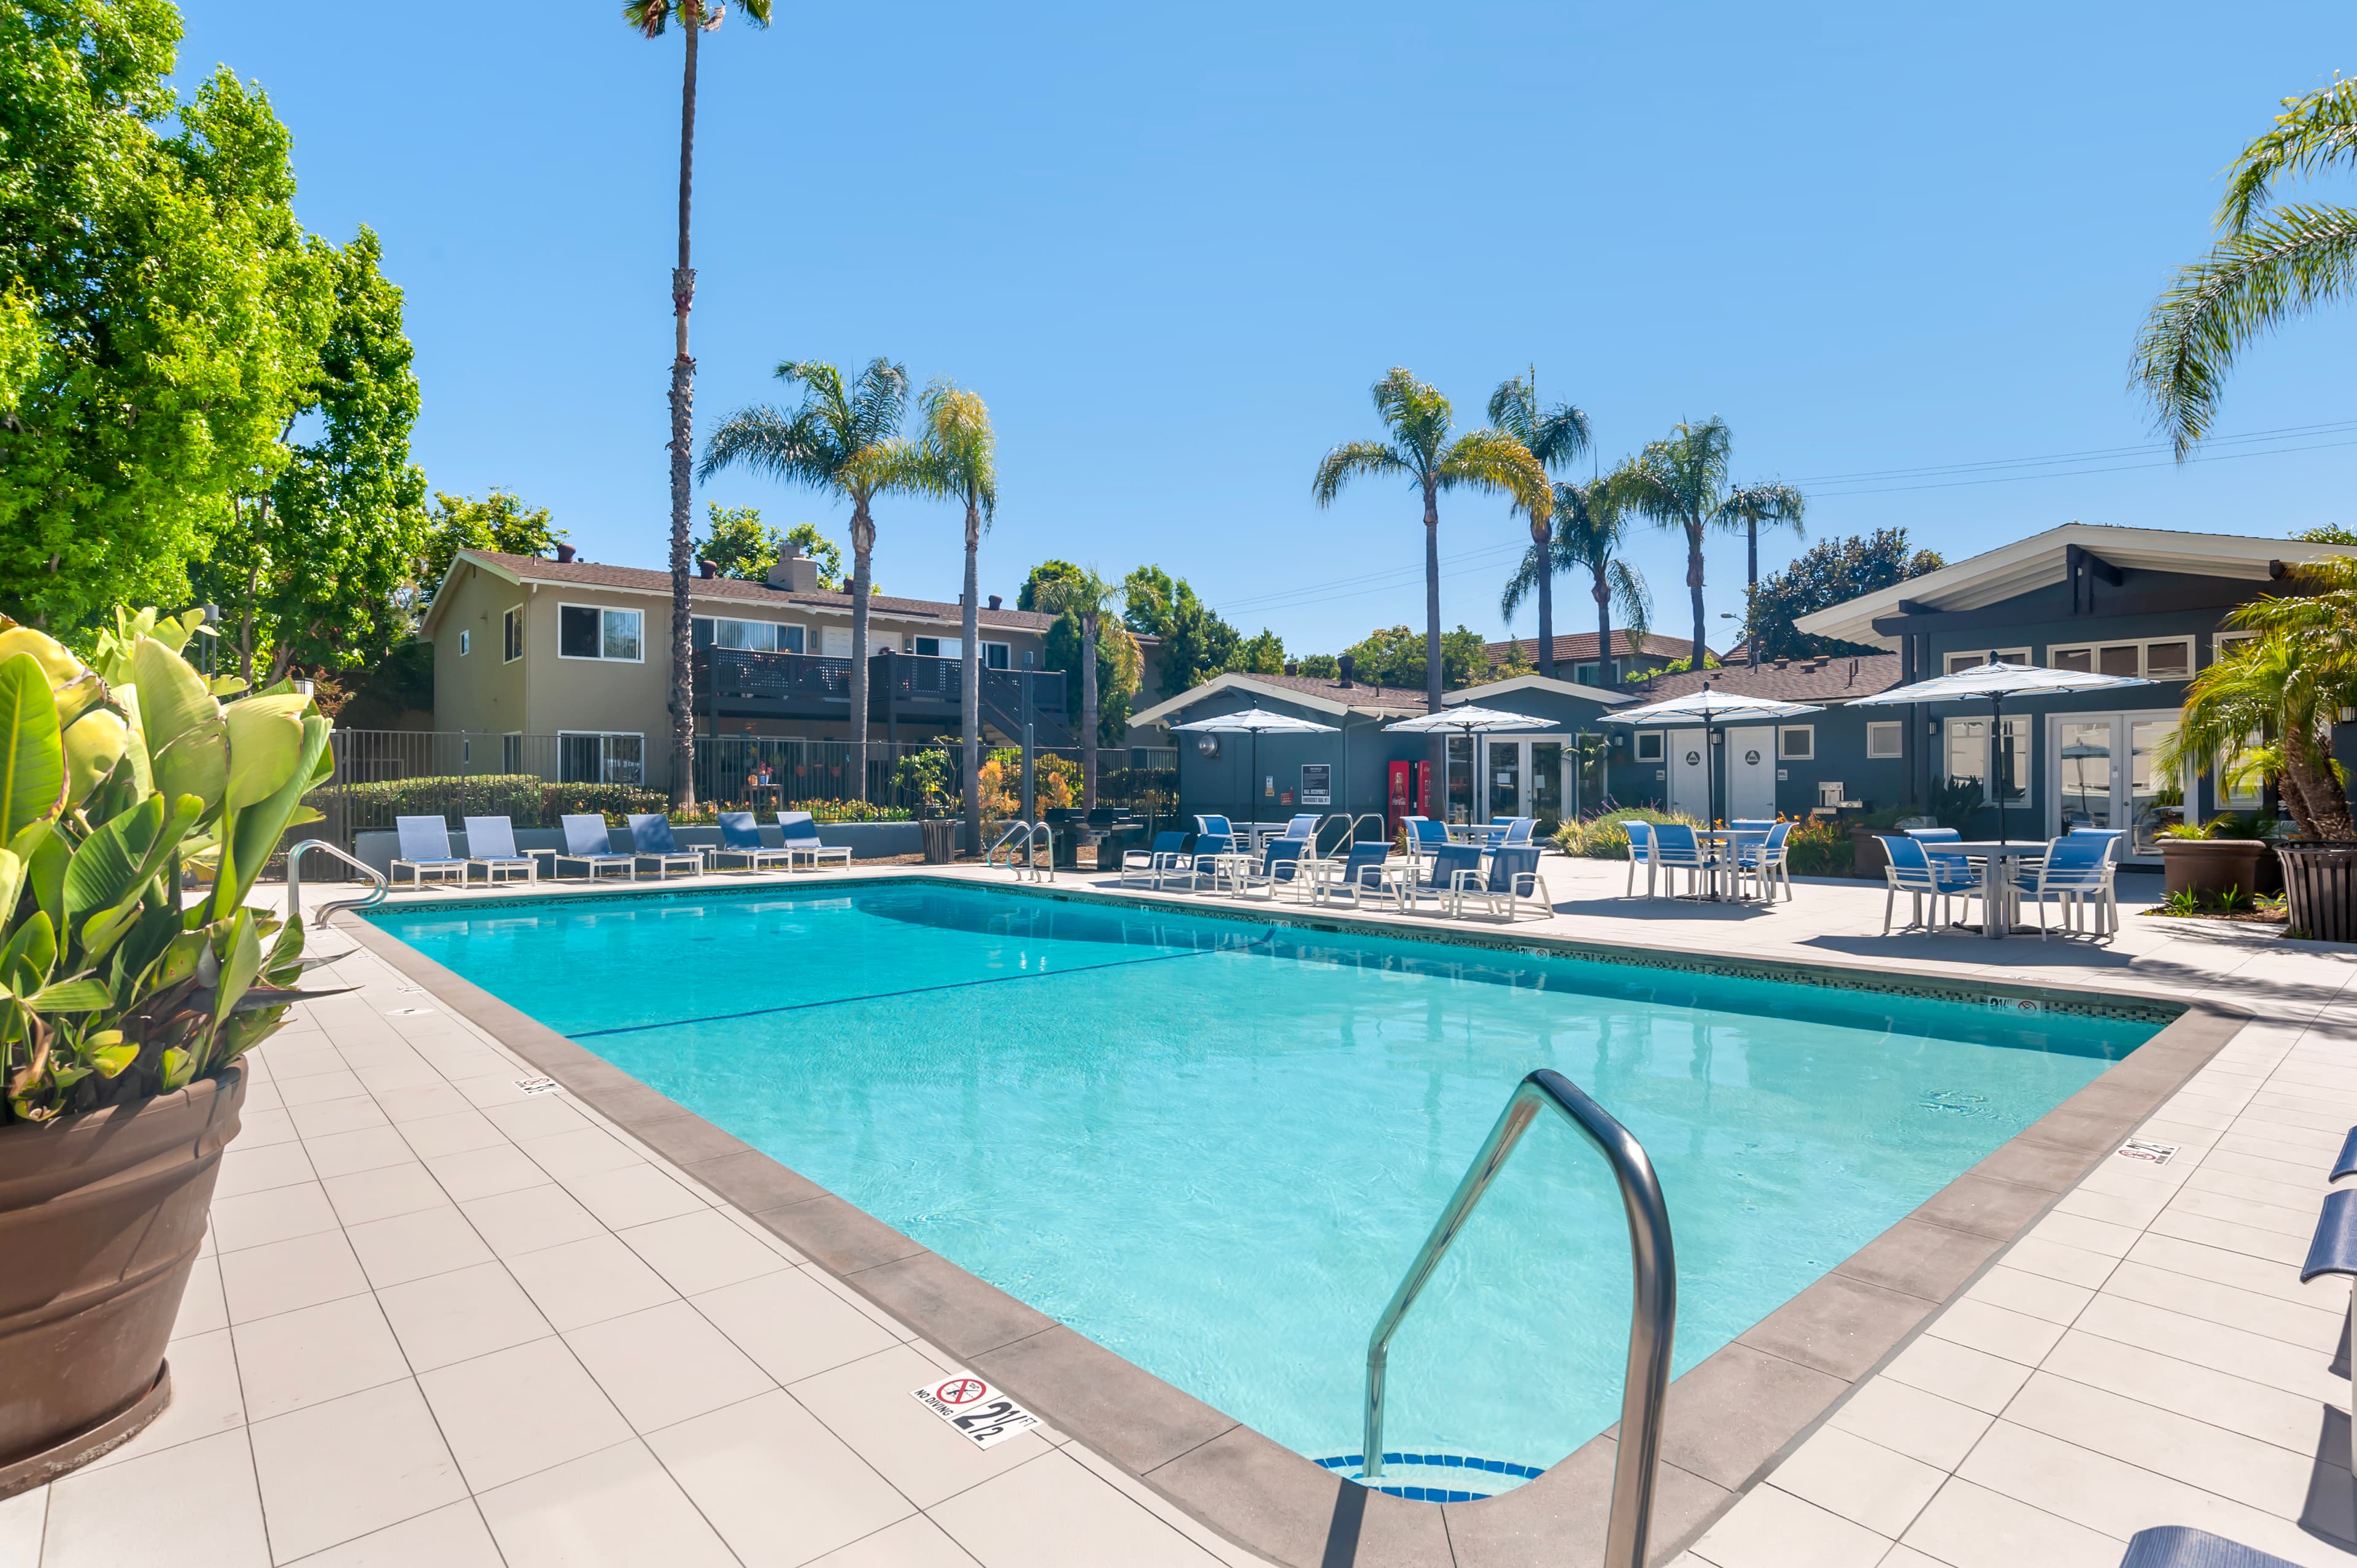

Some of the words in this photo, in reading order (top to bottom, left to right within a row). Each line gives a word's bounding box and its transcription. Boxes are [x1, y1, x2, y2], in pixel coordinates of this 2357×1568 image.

[914, 1389, 930, 1399] NO
[925, 1396, 953, 1416] DIVING
[1019, 1418, 1037, 1427] FT
